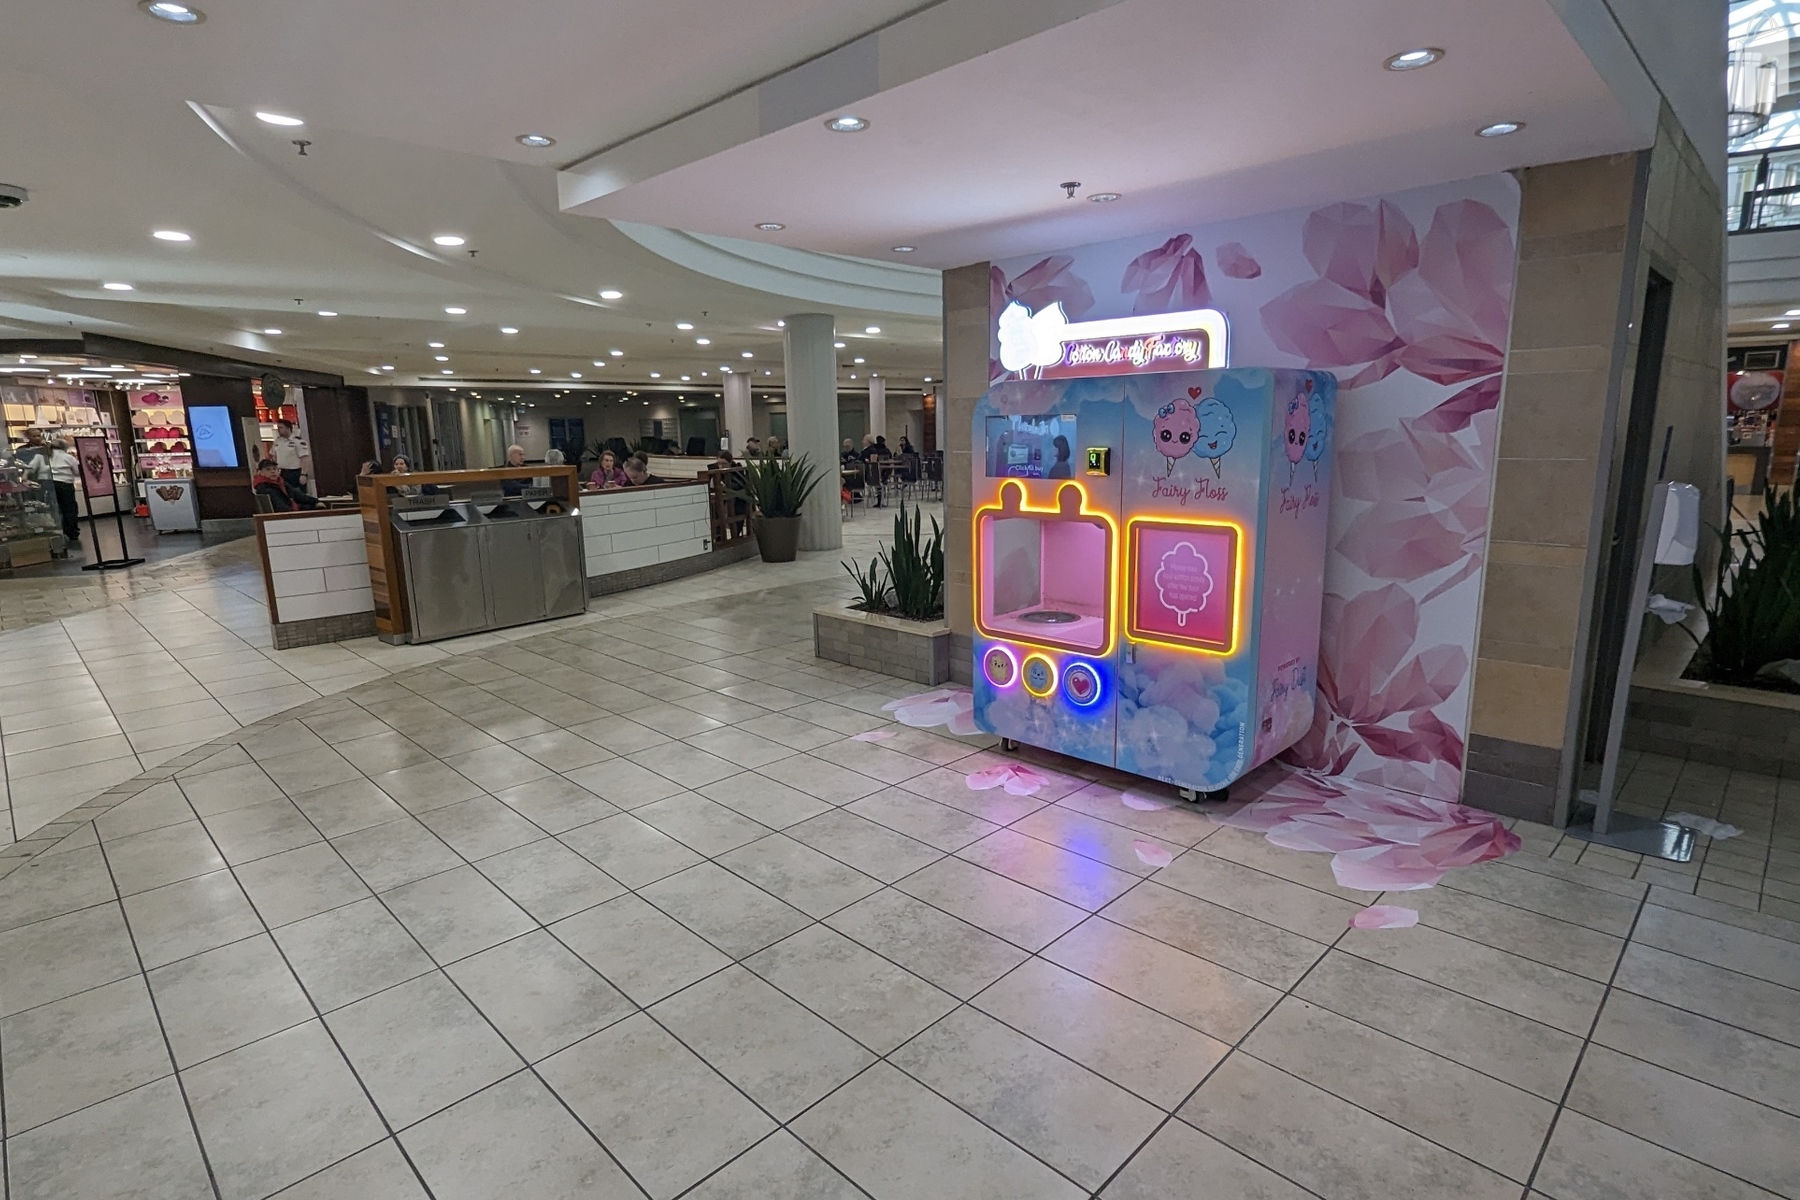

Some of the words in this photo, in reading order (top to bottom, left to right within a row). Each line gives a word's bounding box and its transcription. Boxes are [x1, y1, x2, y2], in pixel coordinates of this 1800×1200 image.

[1065, 342, 1104, 366] Cotton
[1103, 340, 1149, 367] Candy
[1143, 334, 1200, 364] Factory
[408, 497, 436, 506] TRASH
[525, 488, 549, 497] PAPER
[1152, 476, 1190, 506] Fairy
[1194, 477, 1228, 501] Floss
[1280, 487, 1301, 519] Fairy
[1237, 721, 1245, 759] GENERATION
